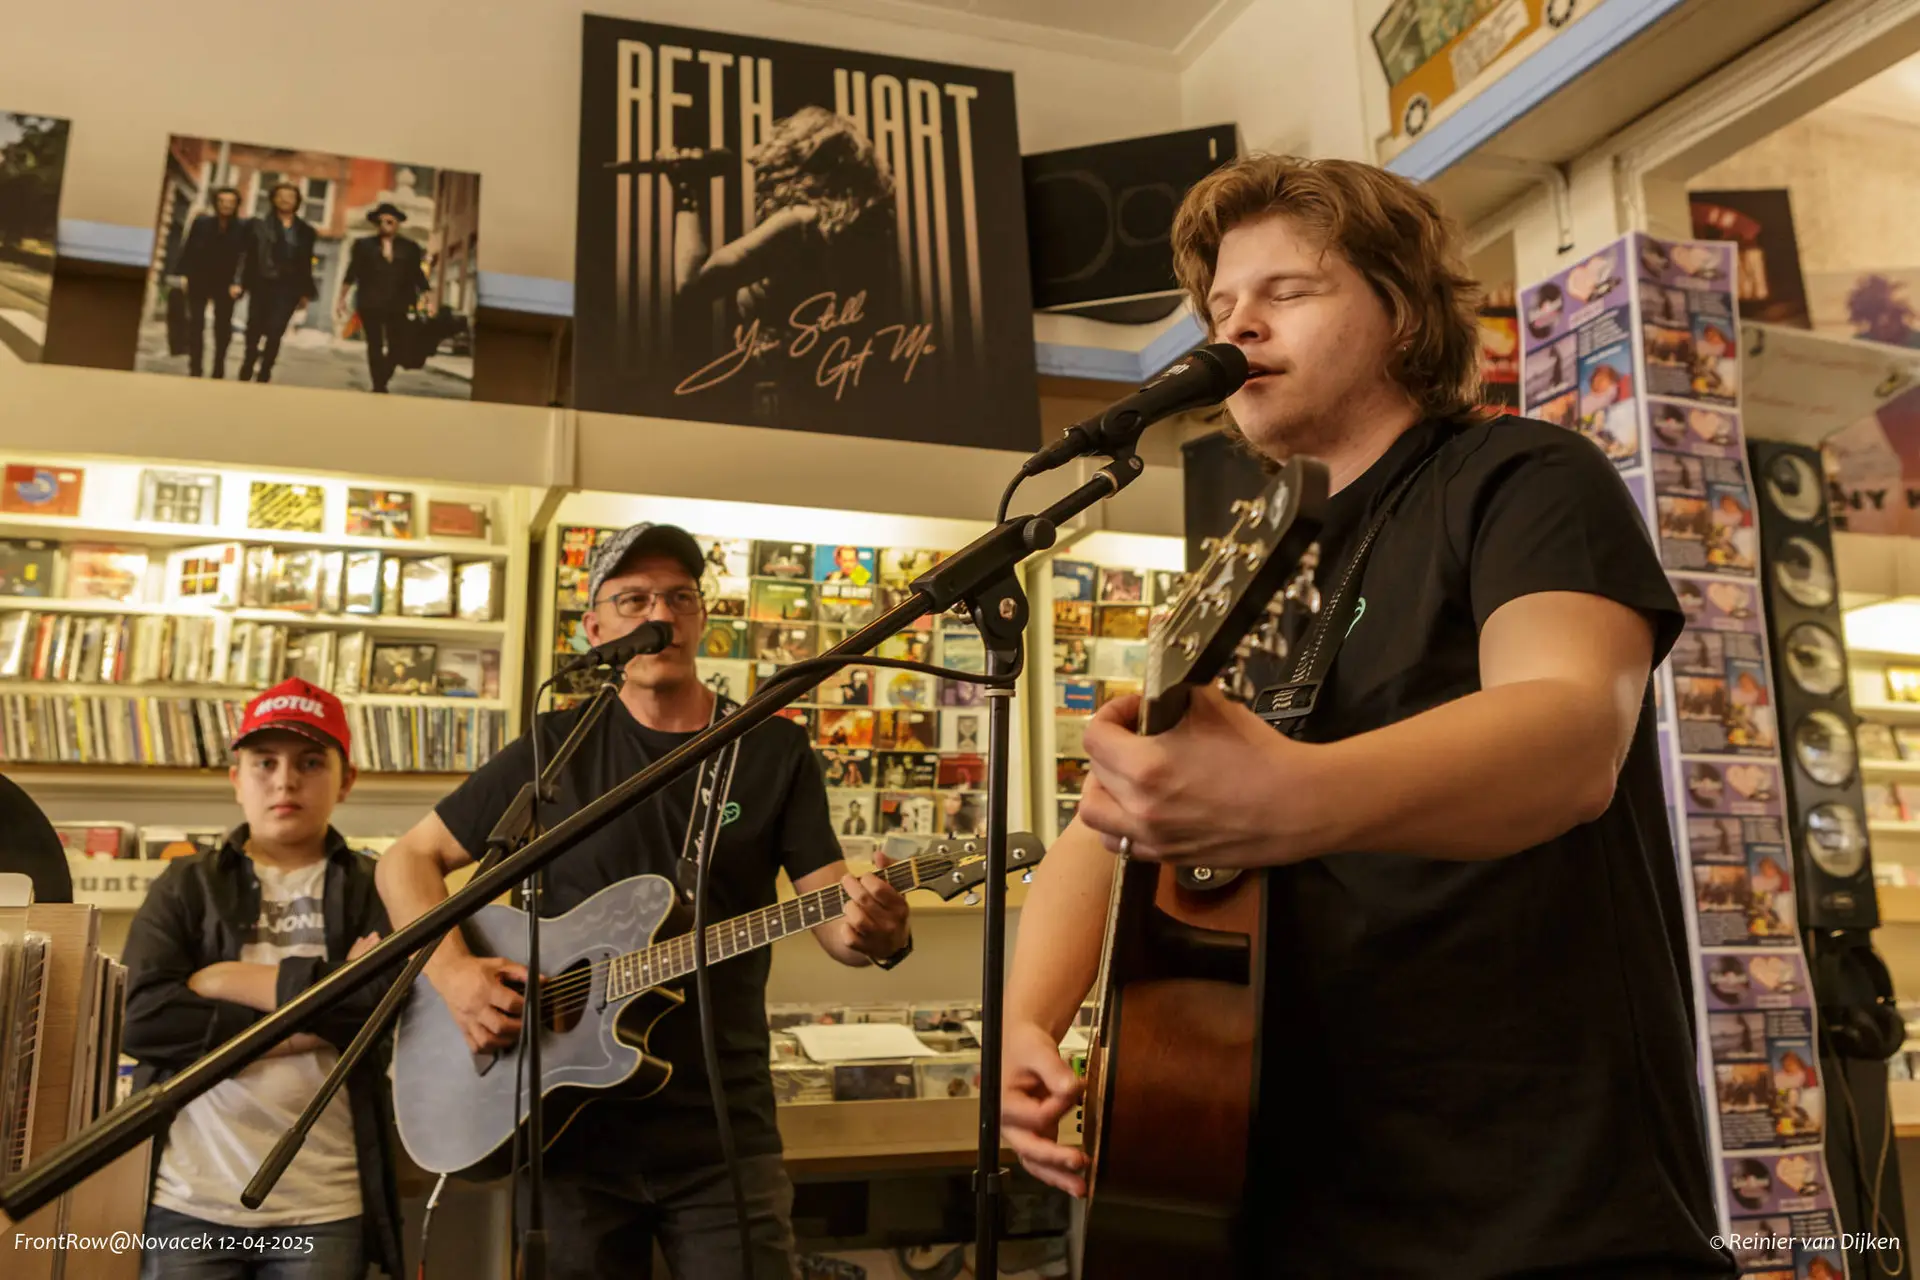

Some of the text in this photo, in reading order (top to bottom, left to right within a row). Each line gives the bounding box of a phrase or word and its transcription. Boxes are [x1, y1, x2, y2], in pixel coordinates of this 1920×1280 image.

[788, 289, 867, 358] Still
[816, 336, 874, 402] Got
[253, 695, 325, 718] MOTUL
